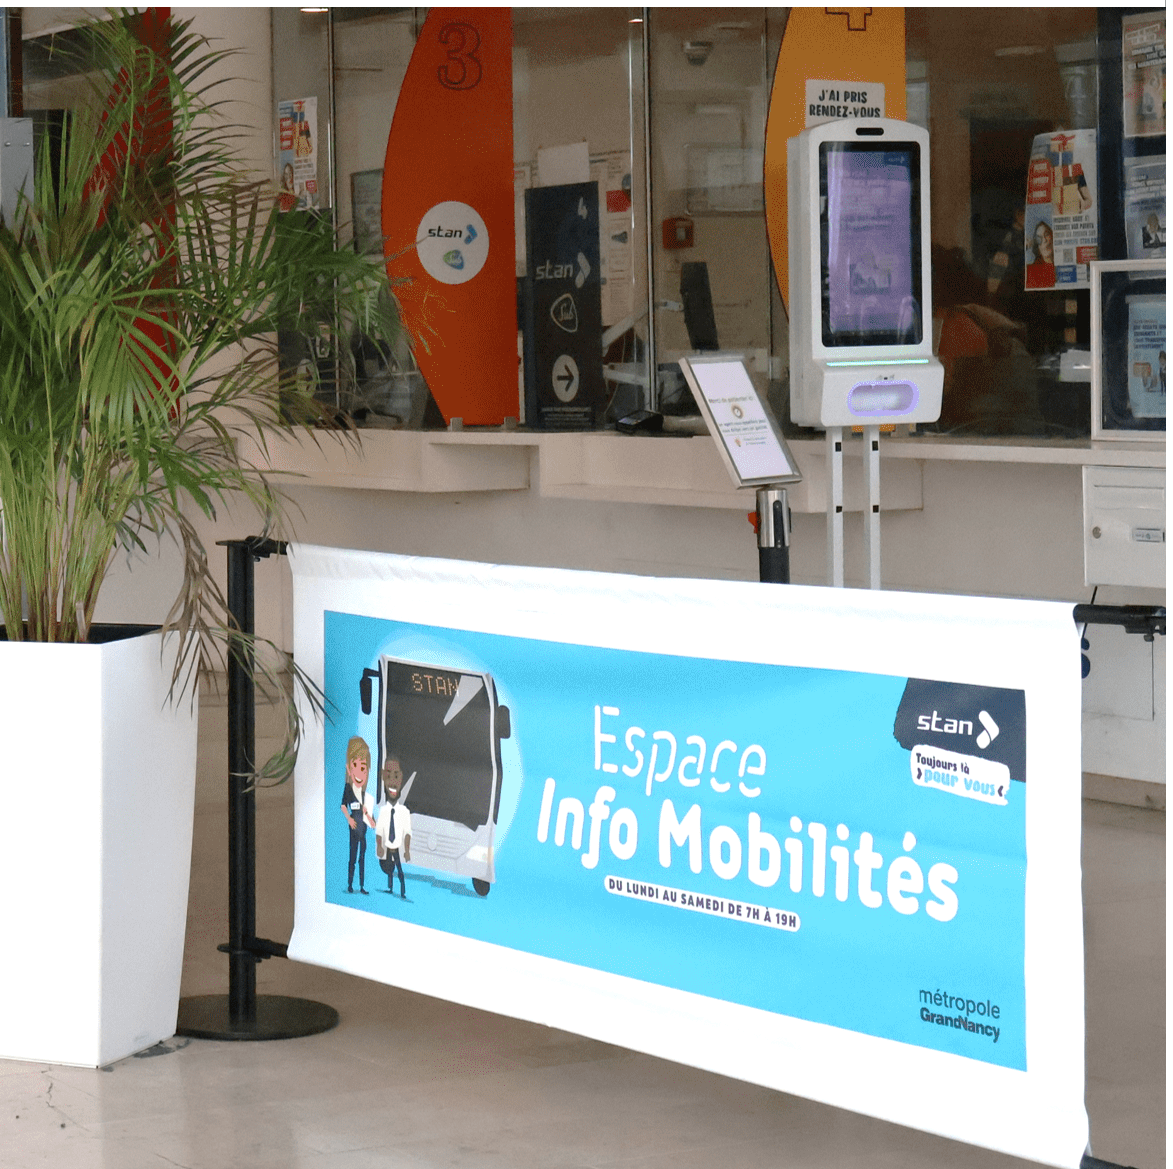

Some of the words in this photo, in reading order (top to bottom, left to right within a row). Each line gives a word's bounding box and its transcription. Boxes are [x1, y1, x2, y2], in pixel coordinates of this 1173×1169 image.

[438, 22, 483, 91] 3
[819, 89, 840, 102] J'AI
[843, 90, 868, 104] PRIS
[809, 104, 881, 118] RENDEZ-VOUS
[428, 226, 462, 238] stan
[536, 260, 573, 280] stan
[412, 673, 459, 697] STAN
[917, 710, 973, 735] stan
[594, 705, 767, 797] Espace
[916, 752, 957, 772] Toujours
[961, 762, 969, 775] là
[924, 769, 958, 787] pour
[964, 777, 995, 796] vous
[536, 778, 638, 869] Info
[658, 798, 959, 922] Mobilités
[609, 878, 623, 891] DU
[627, 882, 659, 899] LUNDI
[663, 889, 677, 903] AU
[681, 893, 724, 912] SAMEDI
[728, 903, 742, 916] DE
[746, 907, 760, 920] 7H
[764, 906, 771, 922] À
[776, 913, 796, 928] 19H
[919, 988, 1000, 1019] métropole
[920, 1006, 1000, 1043] GrandNancy
